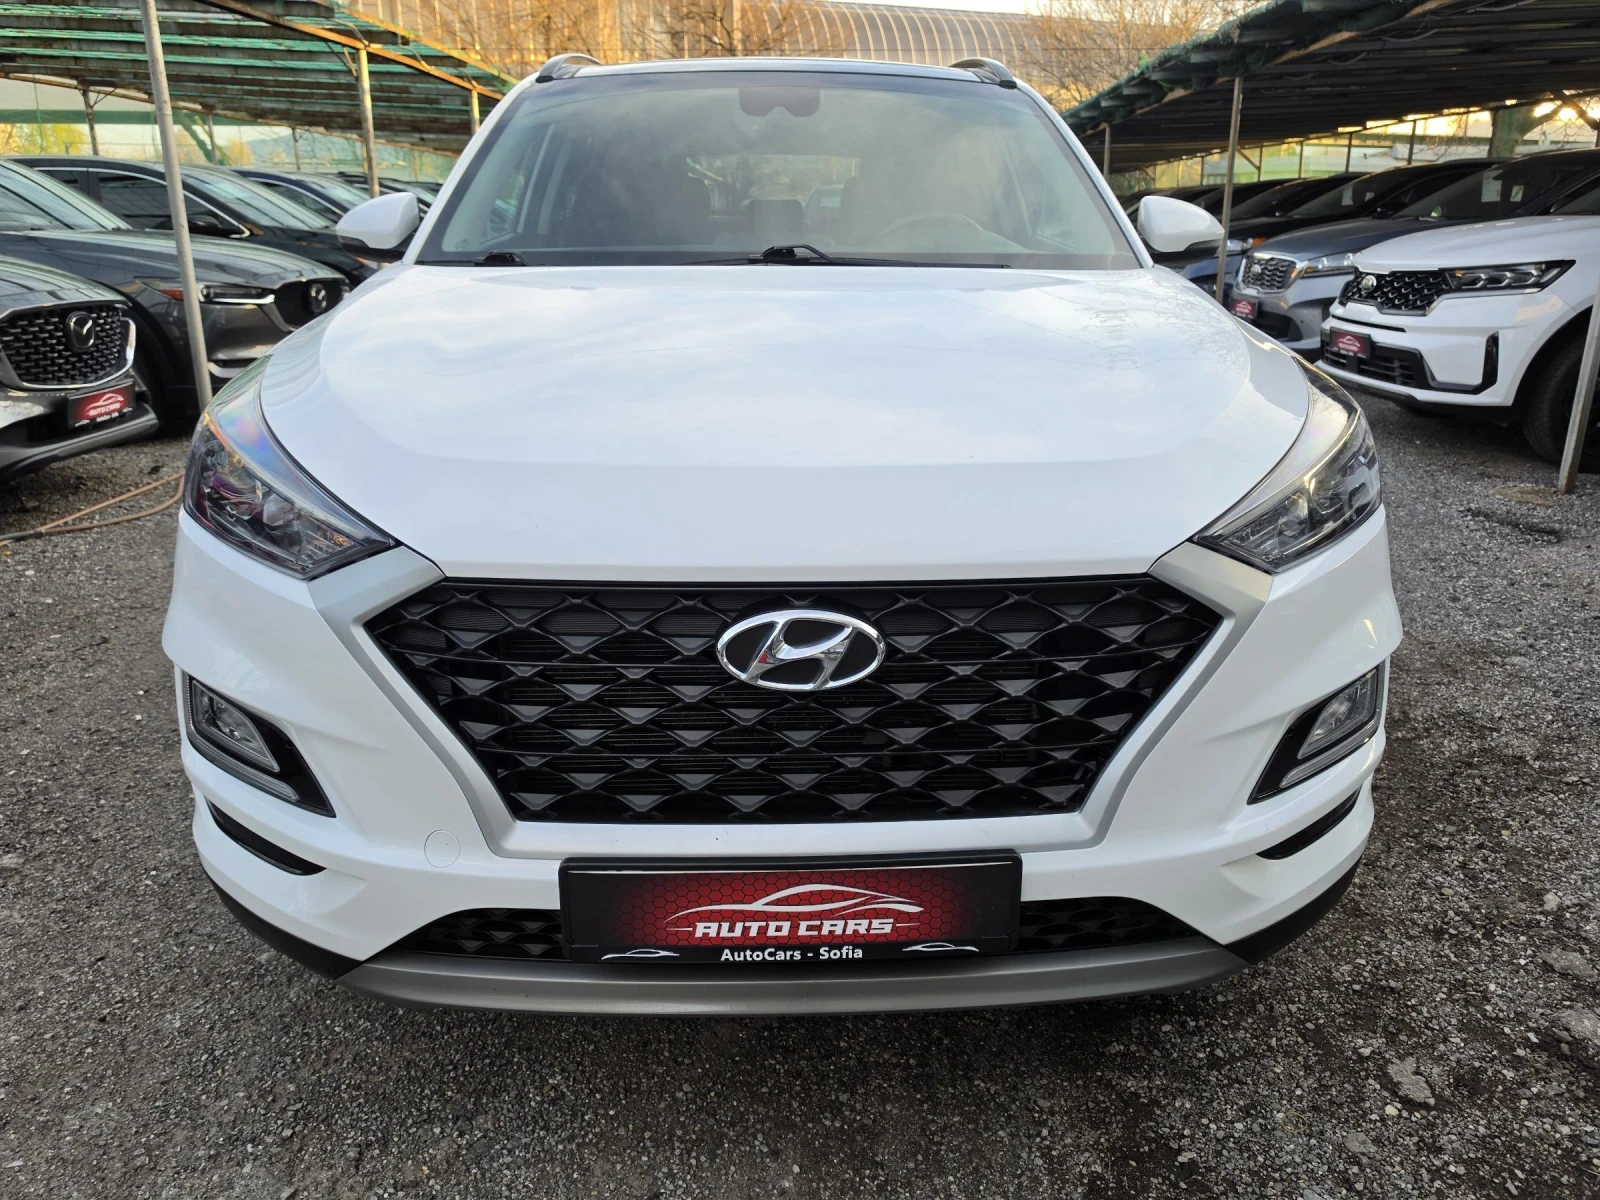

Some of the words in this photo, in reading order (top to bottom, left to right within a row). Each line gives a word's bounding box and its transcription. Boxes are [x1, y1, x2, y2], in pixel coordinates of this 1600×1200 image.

[694, 921, 791, 938] AUTO
[797, 918, 894, 936] CARS
[720, 948, 802, 962] AutoCars
[819, 945, 863, 960] Sofia
